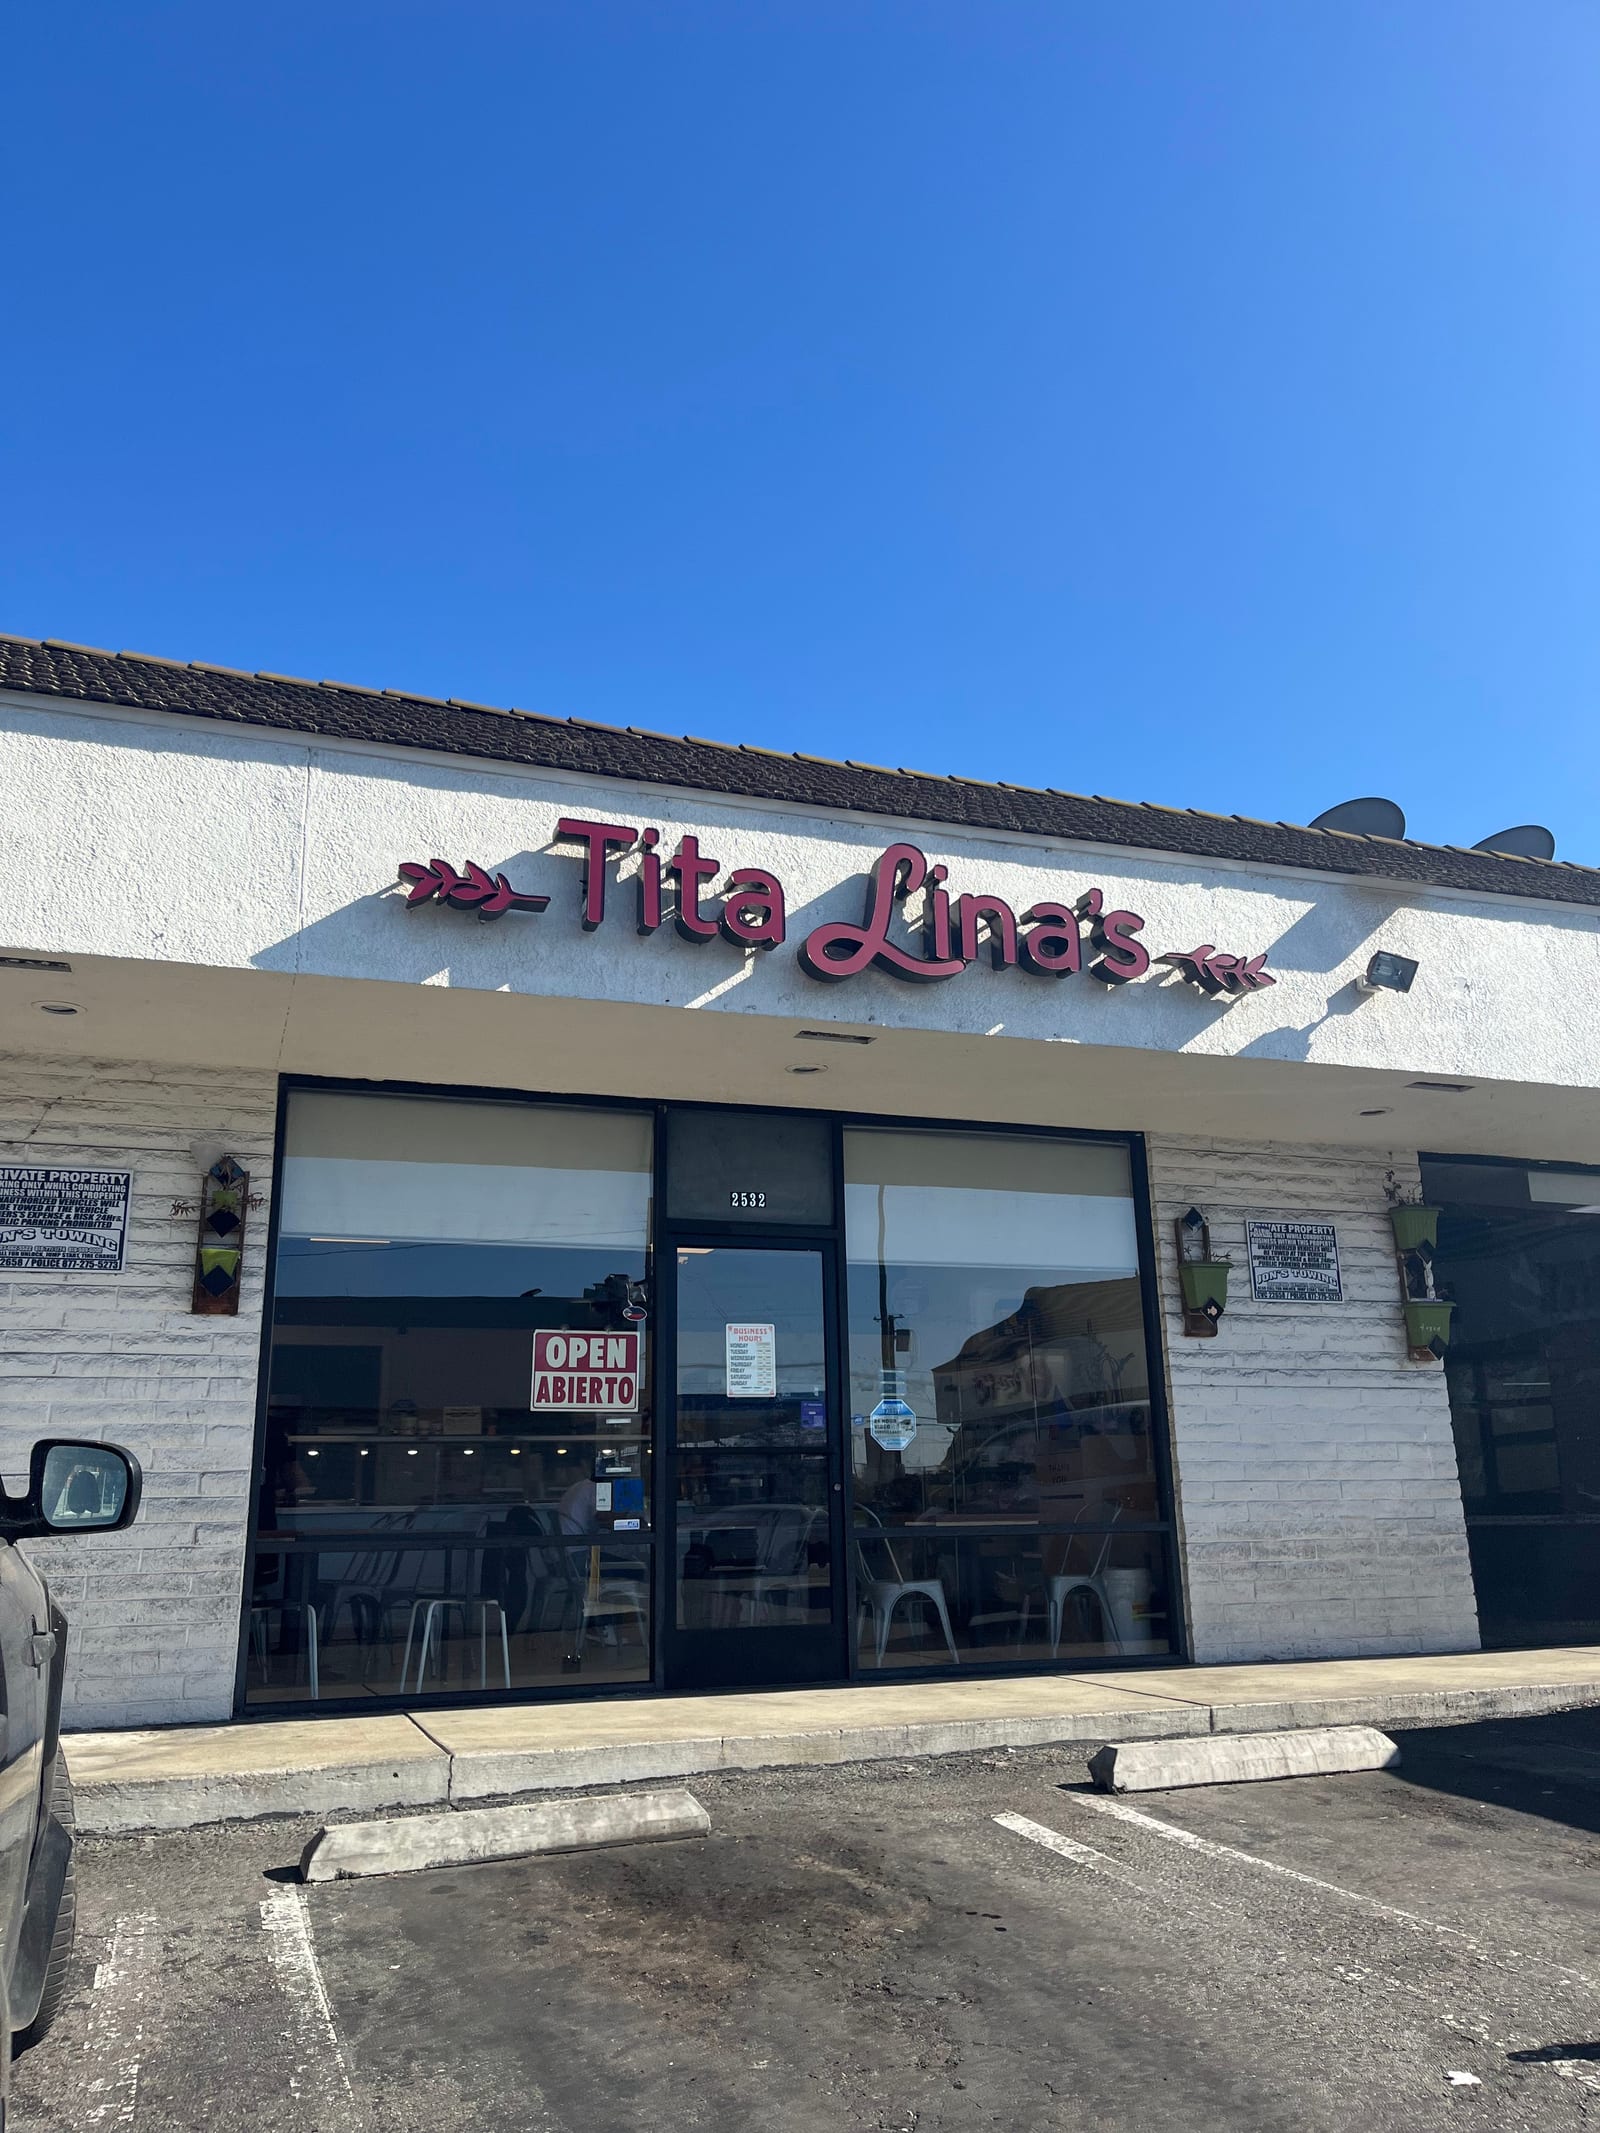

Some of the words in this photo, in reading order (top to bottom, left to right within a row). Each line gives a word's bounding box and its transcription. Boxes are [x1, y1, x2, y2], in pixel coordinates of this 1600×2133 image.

[557, 817, 786, 945] Tita
[803, 843, 1150, 981] Lina's
[49, 1171, 128, 1185] PROPERTY
[21, 1181, 42, 1189] ONLY
[44, 1182, 71, 1190] WHILE
[72, 1183, 126, 1193] CONDUCTING
[0, 1188, 26, 1196] INESS
[27, 1189, 59, 1197] WITHIN
[61, 1190, 81, 1199] THIS
[82, 1191, 125, 1200] PROPERTY
[731, 1192, 765, 1208] 2532
[13, 1203, 44, 1211] TOWED
[74, 1206, 109, 1214] VEHICLE
[59, 1198, 99, 1207] VEHICLES
[100, 1200, 120, 1208] WILL
[27, 1211, 65, 1219] EXPENSE
[73, 1213, 95, 1221] RISK
[21, 1218, 60, 1226] PARKING
[61, 1219, 113, 1228] PROHIBITED
[1288, 1224, 1334, 1235] PROPERTY
[0, 1228, 36, 1243] N'S
[41, 1227, 118, 1252] TOWING
[31, 1258, 61, 1267] POLICE
[62, 1259, 118, 1269] 877-275-5273
[1257, 1268, 1289, 1284] JON'S
[1291, 1268, 1338, 1287] TOWING
[545, 1335, 627, 1369] OPEN
[536, 1375, 634, 1405] ABIERTO
